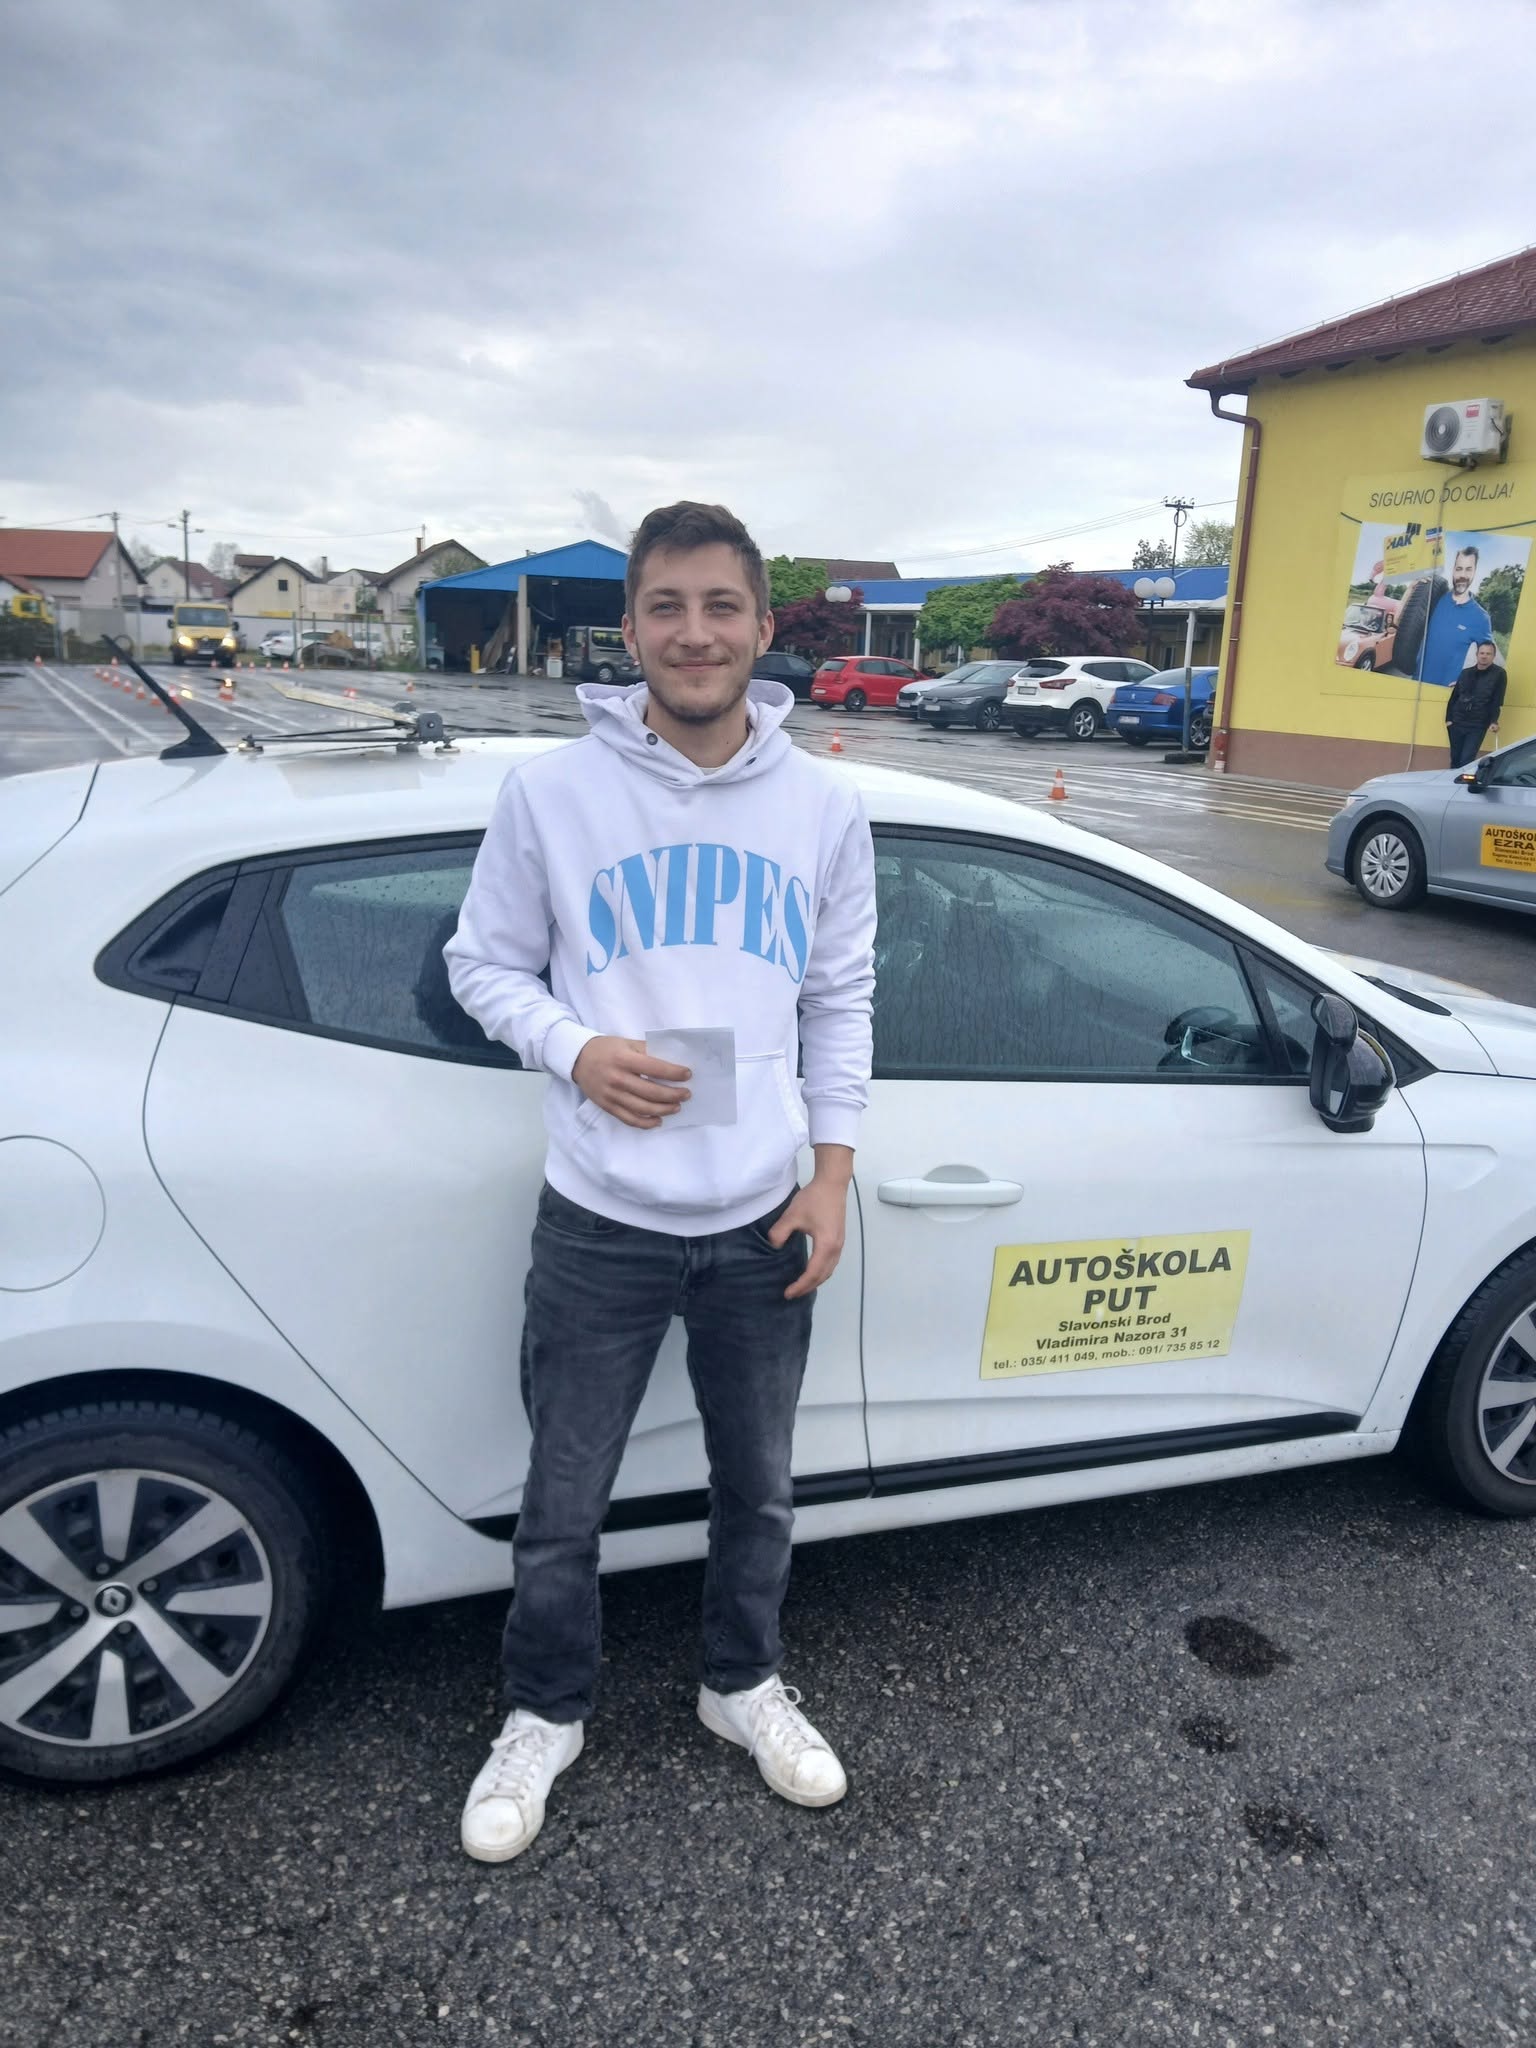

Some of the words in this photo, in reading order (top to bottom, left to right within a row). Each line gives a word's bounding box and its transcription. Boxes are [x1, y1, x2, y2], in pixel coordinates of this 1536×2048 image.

[1369, 488, 1436, 508] SIGURNO
[1439, 486, 1462, 503] DO
[1464, 481, 1515, 501] CILJA!
[1494, 838, 1535, 850] EZRA
[587, 843, 810, 984] SNIPES
[1008, 1247, 1231, 1287] AUTOŠKOLA
[1083, 1285, 1157, 1314] PUT
[1058, 1316, 1131, 1332] Slavonski
[1136, 1313, 1171, 1326] Brod
[1036, 1334, 1109, 1350] Vladimira
[1114, 1330, 1166, 1343] Nazora
[1170, 1326, 1187, 1338] 31
[994, 1360, 1017, 1369] tel.:
[1021, 1355, 1047, 1367] 035/
[1050, 1353, 1070, 1364] 411
[1102, 1348, 1135, 1359] mob.:
[1139, 1345, 1163, 1355] 091/
[1167, 1342, 1186, 1352] 735
[1189, 1341, 1203, 1350] 85
[1207, 1339, 1220, 1348] 12
